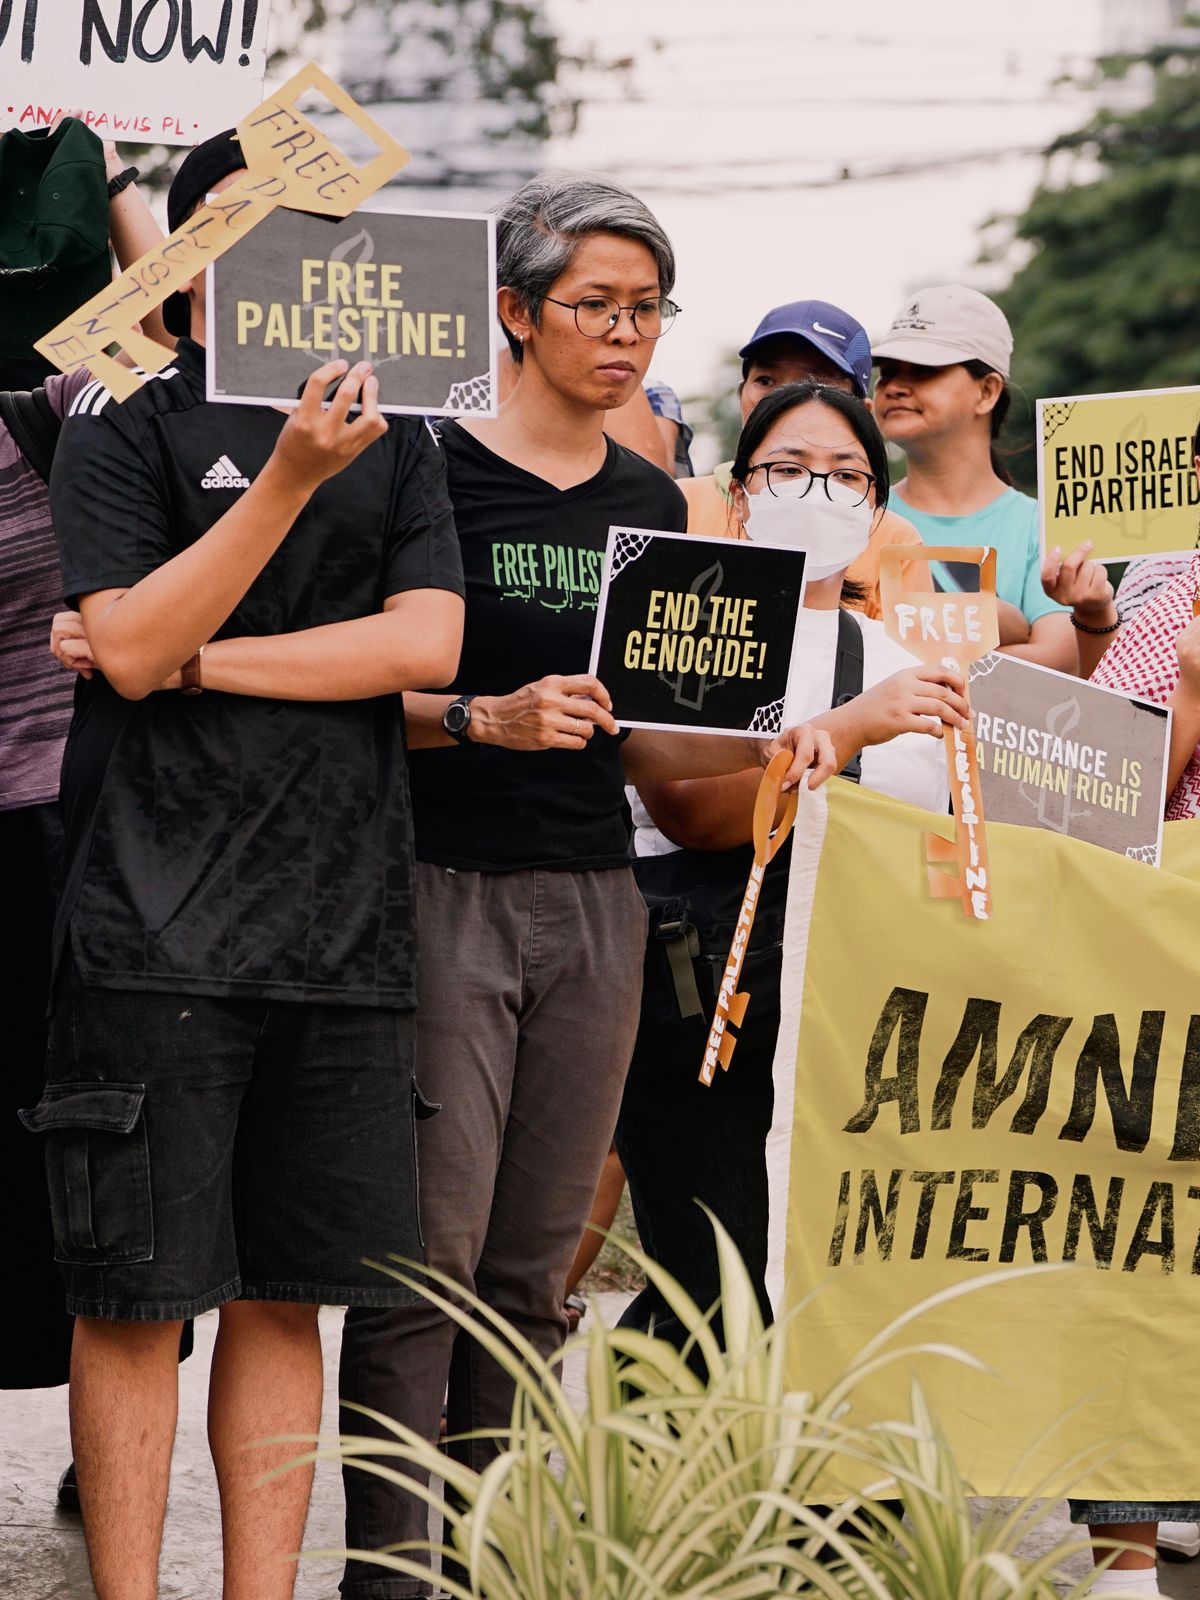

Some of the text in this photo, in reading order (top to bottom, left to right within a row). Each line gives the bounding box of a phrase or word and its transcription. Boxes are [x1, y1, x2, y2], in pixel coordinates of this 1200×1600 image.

[79, 0, 259, 67] NOW!
[20, 104, 186, 135] ANPAWIS PL
[250, 104, 360, 200] FREE
[302, 259, 403, 309] FREE
[237, 300, 466, 358] PALESTINE!
[200, 474, 250, 489] adidas
[1055, 444, 1104, 480] END
[1054, 471, 1200, 518] APARTHEID
[492, 543, 607, 594] FREE PALEST
[646, 590, 757, 637] END THE
[893, 604, 984, 644] FREE
[624, 630, 767, 680] GENOCIDE!
[977, 711, 1142, 789] RESISTANCE IS
[942, 656, 989, 920] LESTINE
[975, 742, 1142, 817] A HUMAN RIGHT
[702, 1010, 726, 1084] FREE
